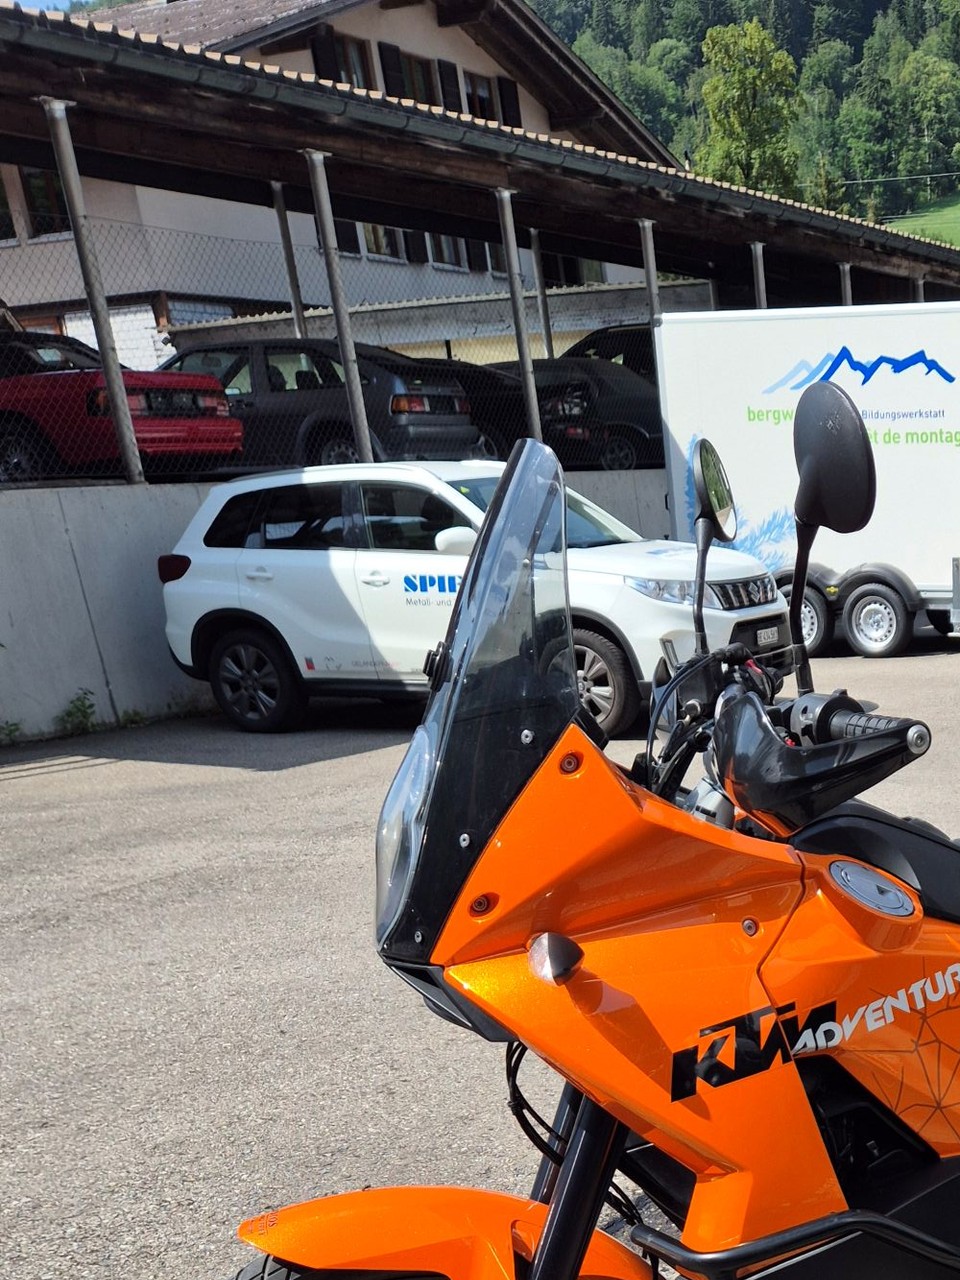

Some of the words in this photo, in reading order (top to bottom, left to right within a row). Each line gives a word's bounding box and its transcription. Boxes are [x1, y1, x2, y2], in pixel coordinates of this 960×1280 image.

[861, 409, 945, 421] Bildungswerkstatt
[883, 429, 901, 444] de
[671, 999, 837, 1104] KTM
